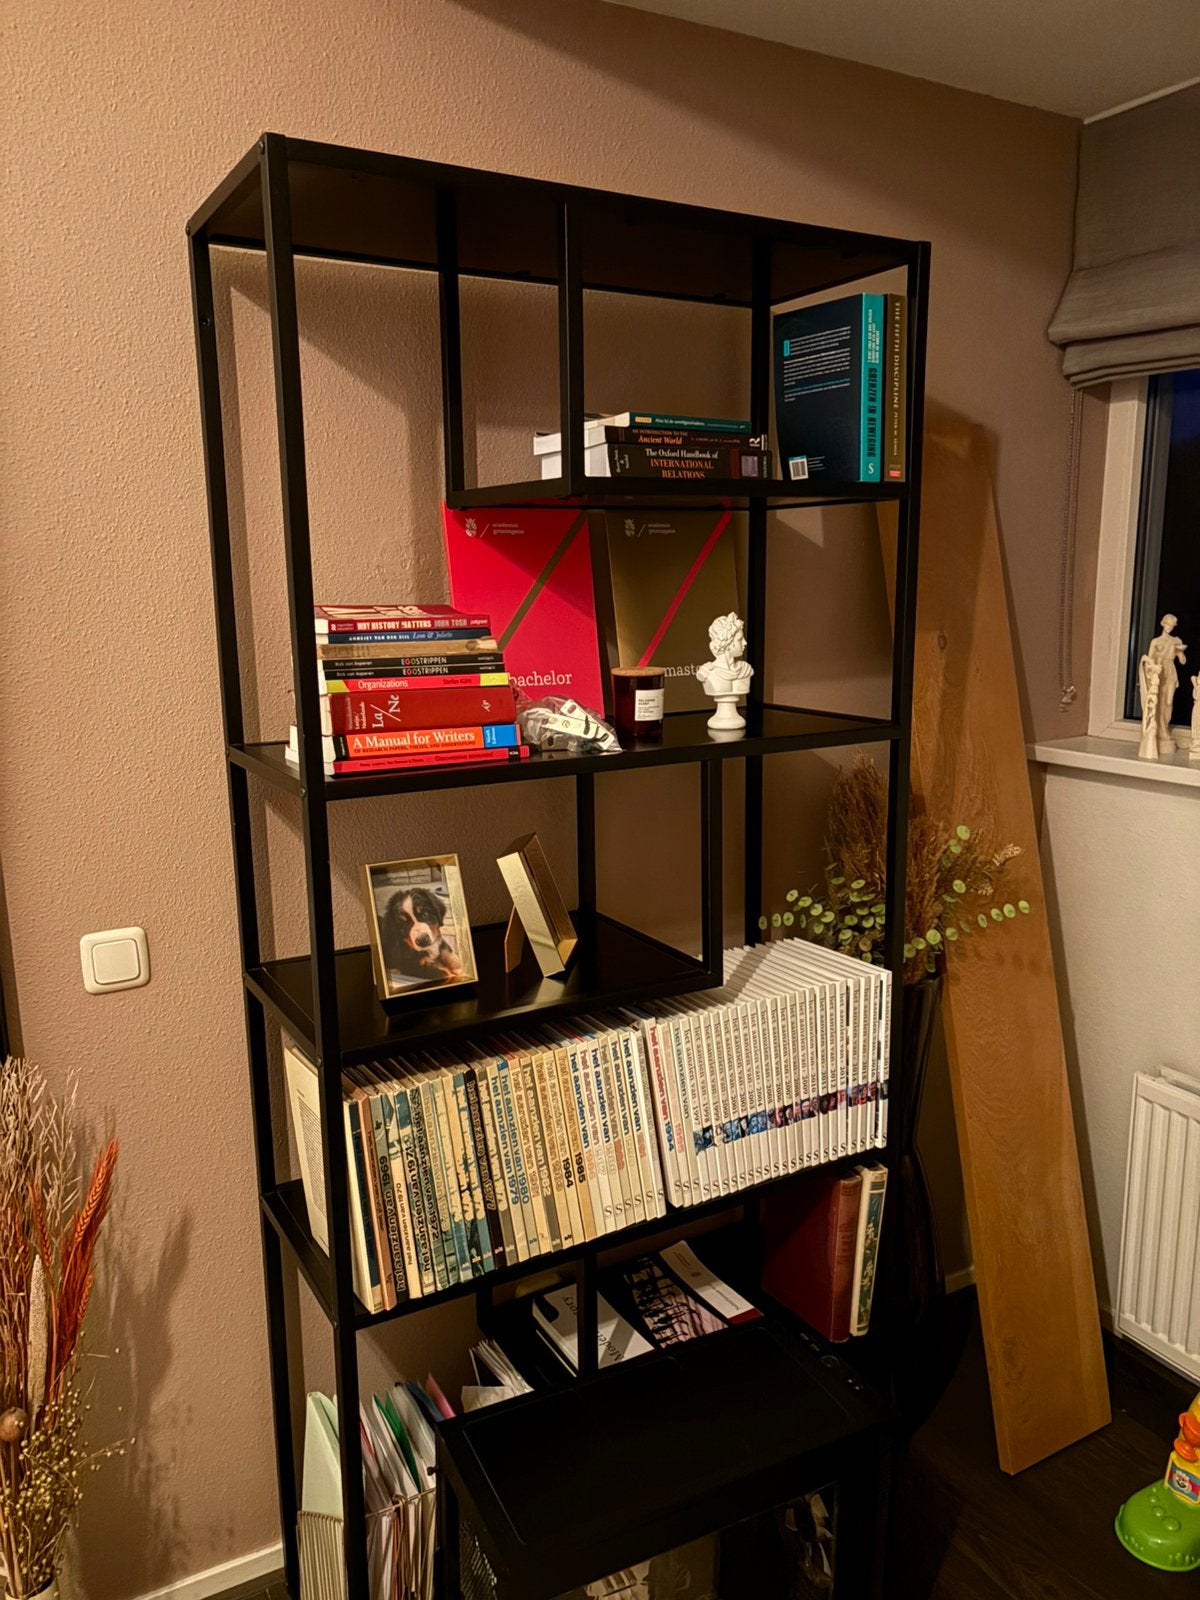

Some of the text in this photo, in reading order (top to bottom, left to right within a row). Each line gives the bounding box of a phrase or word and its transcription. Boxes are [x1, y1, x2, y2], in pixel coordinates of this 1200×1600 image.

[868, 405, 877, 414] IN
[639, 435, 662, 444] Ancient
[664, 436, 682, 445] World
[645, 448, 719, 458] The Oxford Handbook of
[650, 458, 714, 470] INTERNATIONAL
[662, 470, 705, 479] RELATIONS
[356, 622, 370, 630] WHY
[372, 620, 400, 630] HISTORY
[400, 620, 432, 629] MATTERS
[401, 657, 447, 666] EGOSTRIPPEN
[402, 667, 448, 676] EGOSTRIPPEN
[358, 680, 408, 691] Organizations
[388, 694, 400, 713] Ne
[372, 712, 384, 728] La
[353, 738, 363, 748] A
[366, 733, 410, 747] Manual
[413, 732, 430, 744] for
[432, 731, 475, 742] Writers
[611, 1041, 620, 1061] het
[624, 1038, 632, 1058] het
[570, 1052, 579, 1073] het
[686, 1047, 694, 1080] aanzien
[615, 1063, 626, 1112] aanzien
[626, 1060, 638, 1109] aanzien
[650, 1026, 658, 1047] het
[654, 1048, 665, 1098] aanzien
[665, 1121, 674, 1151] 1994
[677, 1049, 687, 1097] aanzien
[682, 1100, 690, 1119] van
[574, 1075, 586, 1125] aanzien
[580, 1050, 599, 1145] het aanzien van
[592, 1048, 610, 1143] het aanzien van
[633, 1109, 641, 1131] van
[470, 1103, 486, 1155] aanzien
[480, 1155, 490, 1180] van
[491, 1076, 519, 1205] het aanzien van 1979
[501, 1075, 529, 1204] het aanzien van 1980
[527, 1090, 540, 1140] aanzien
[534, 1140, 545, 1166] van
[540, 1166, 551, 1196] 1982
[841, 1143, 846, 1152] S
[852, 1139, 857, 1149] S
[791, 1158, 796, 1168] S
[824, 1148, 829, 1158] S
[379, 1155, 391, 1187] 1969
[562, 1158, 573, 1188] 1984
[575, 1152, 586, 1183] 1985
[764, 1165, 770, 1175] S
[396, 1182, 404, 1203] 1970
[646, 1190, 652, 1202] S
[683, 1181, 689, 1192] S
[703, 1184, 709, 1195] S
[384, 1188, 396, 1217] van
[405, 1146, 431, 1272] het aanzien van 1971
[425, 1188, 434, 1210] van
[625, 1198, 632, 1210] S
[605, 1205, 612, 1217] S
[402, 1219, 411, 1253] aanzien
[428, 1211, 440, 1240] 1972
[388, 1218, 404, 1268] aanzien
[598, 1332, 624, 1362] Mode
